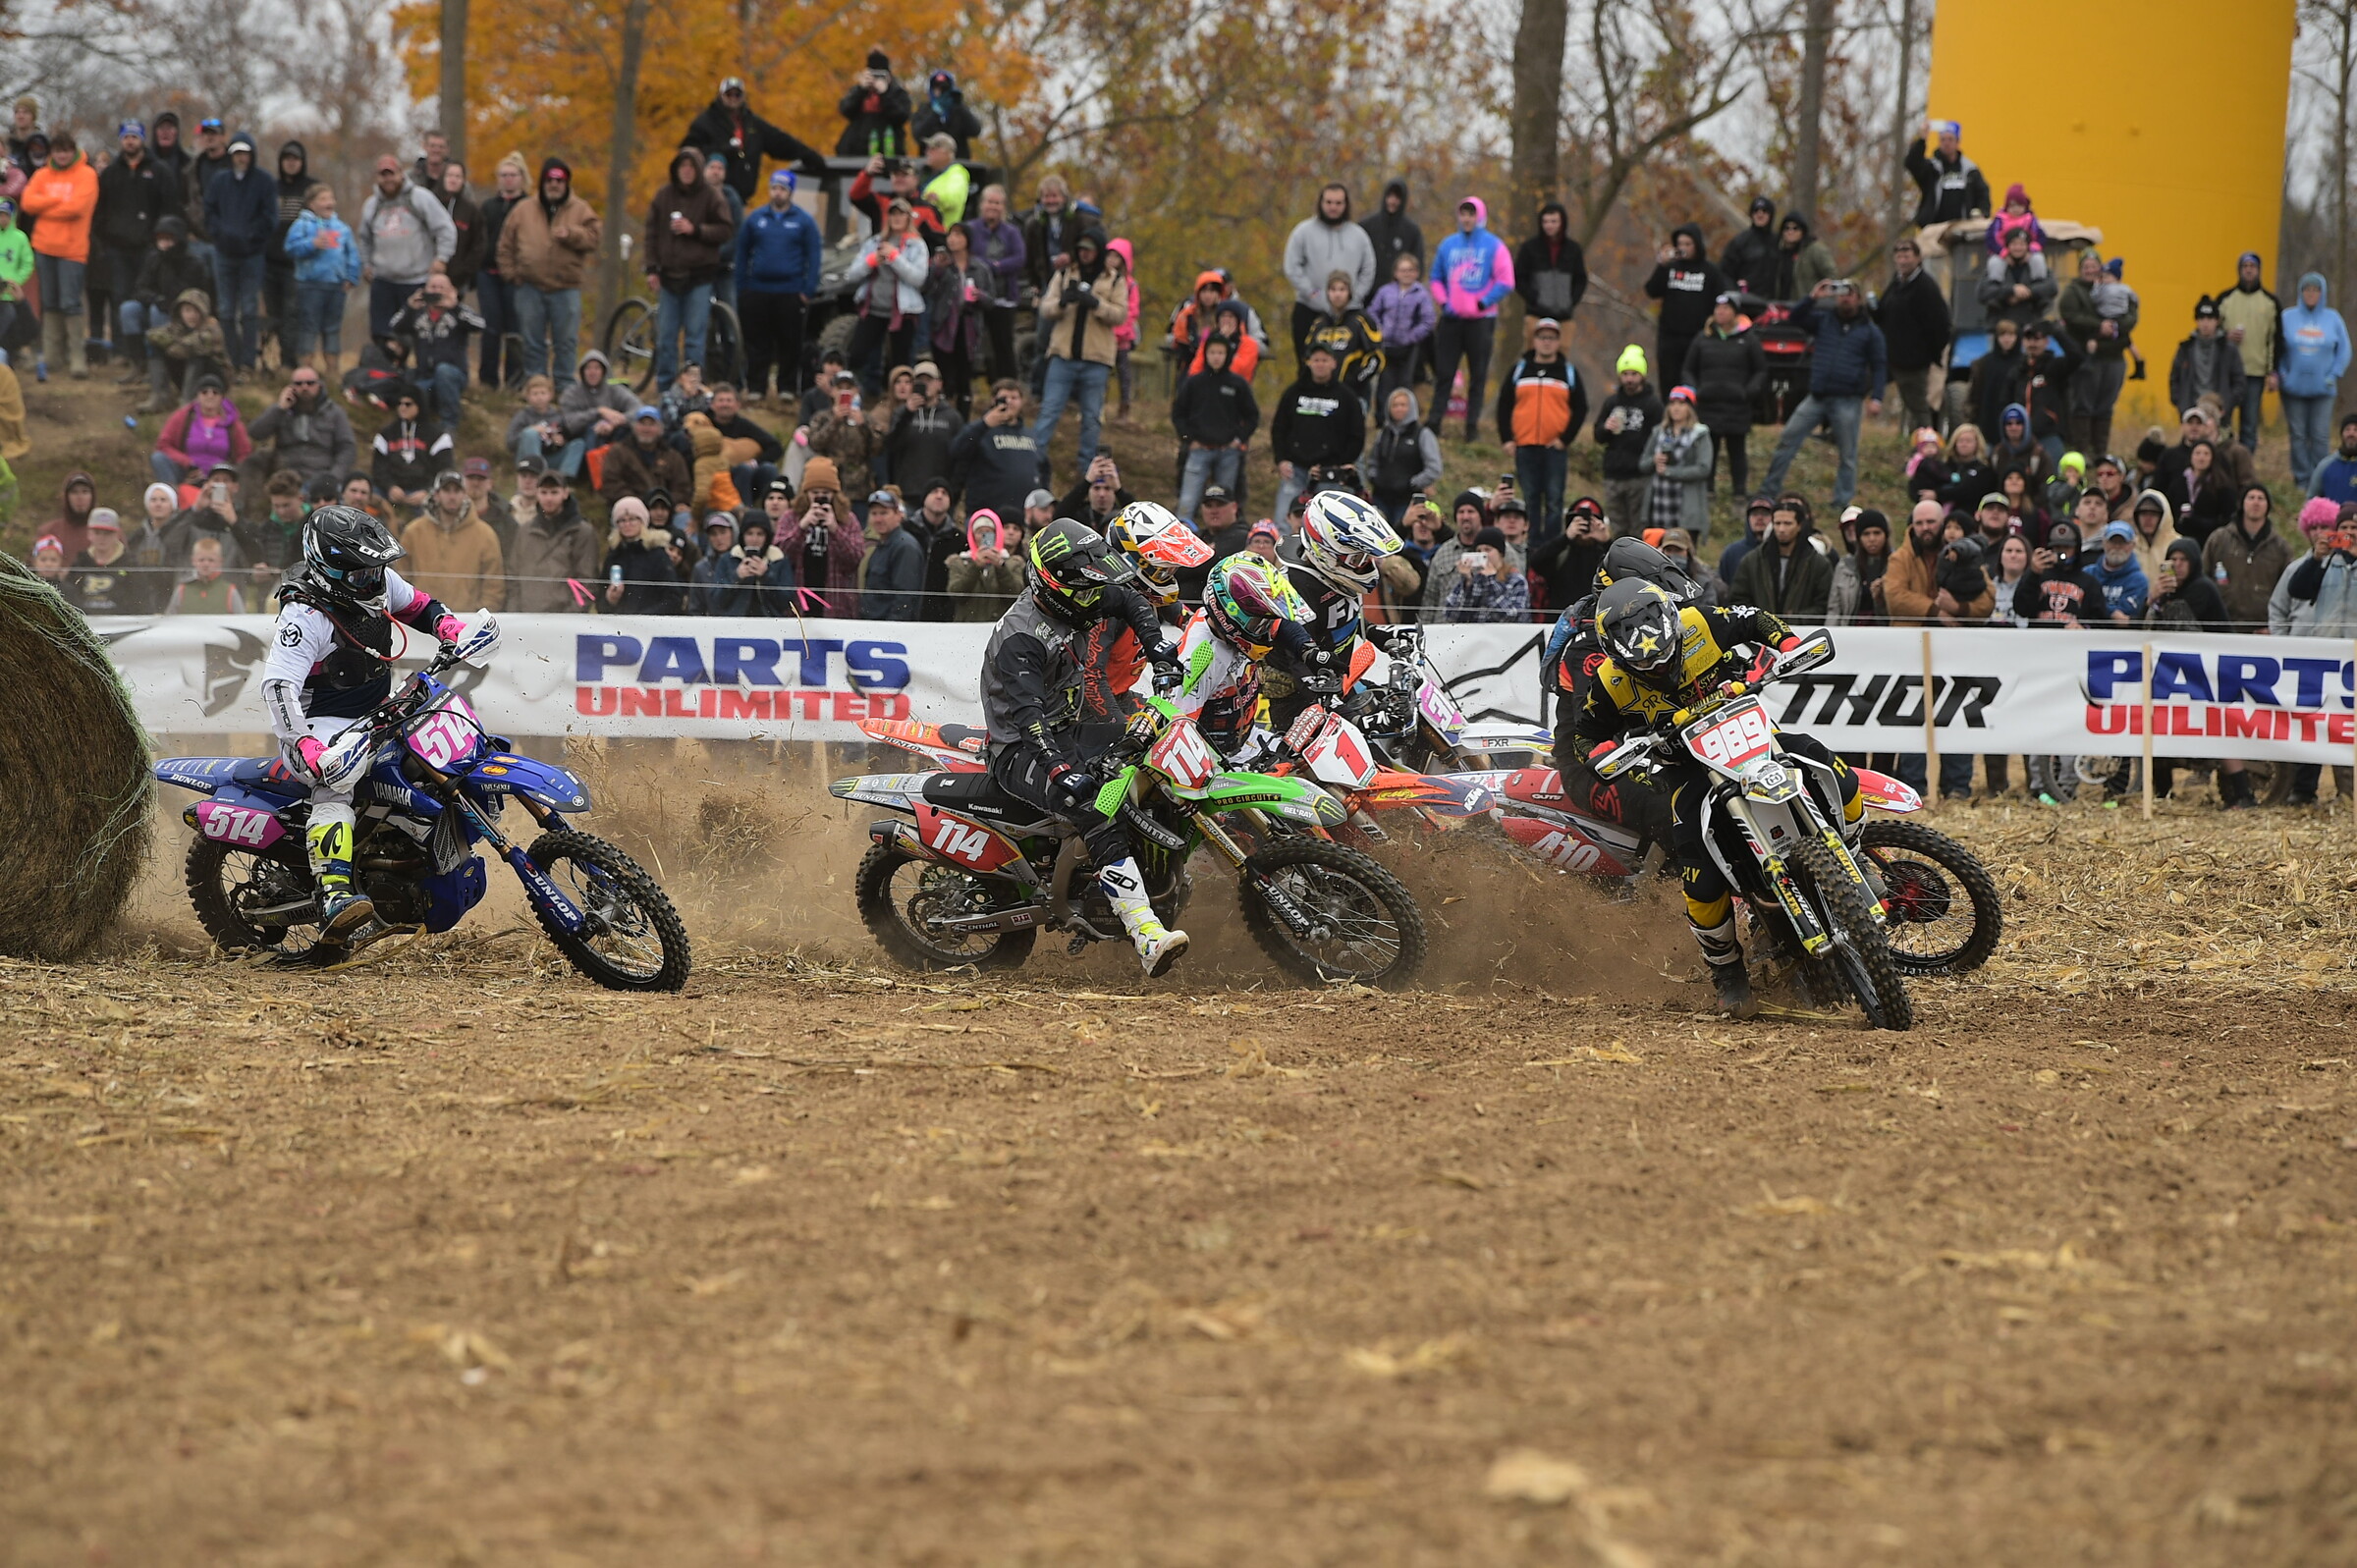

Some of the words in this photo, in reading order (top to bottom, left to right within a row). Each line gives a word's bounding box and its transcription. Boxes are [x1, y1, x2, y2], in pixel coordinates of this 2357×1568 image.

[576, 634, 910, 688] PARTS
[2087, 650, 2355, 709] PART
[576, 686, 910, 721] UNLIMITED
[1779, 674, 2001, 728] THOR
[414, 695, 479, 769] 514
[882, 734, 926, 753] DUNLOP
[1487, 737, 1509, 747] FXR
[1700, 710, 1770, 767] 989
[2085, 703, 2355, 744] UNLIMITE
[1160, 721, 1210, 787] 114
[1334, 730, 1369, 782] 1
[170, 773, 213, 790] DUNLOP
[373, 781, 412, 807] YAMAHA
[852, 792, 889, 803] DUNLOP
[1217, 797, 1235, 806] PRO
[1235, 793, 1273, 803] CIRCUIT
[1462, 786, 1485, 812] KTM
[203, 805, 271, 845] 514
[967, 803, 1004, 815] Kawasaki
[1122, 802, 1178, 846] BABBITT'S
[931, 818, 991, 862] 114
[284, 905, 318, 922] YAMAH
